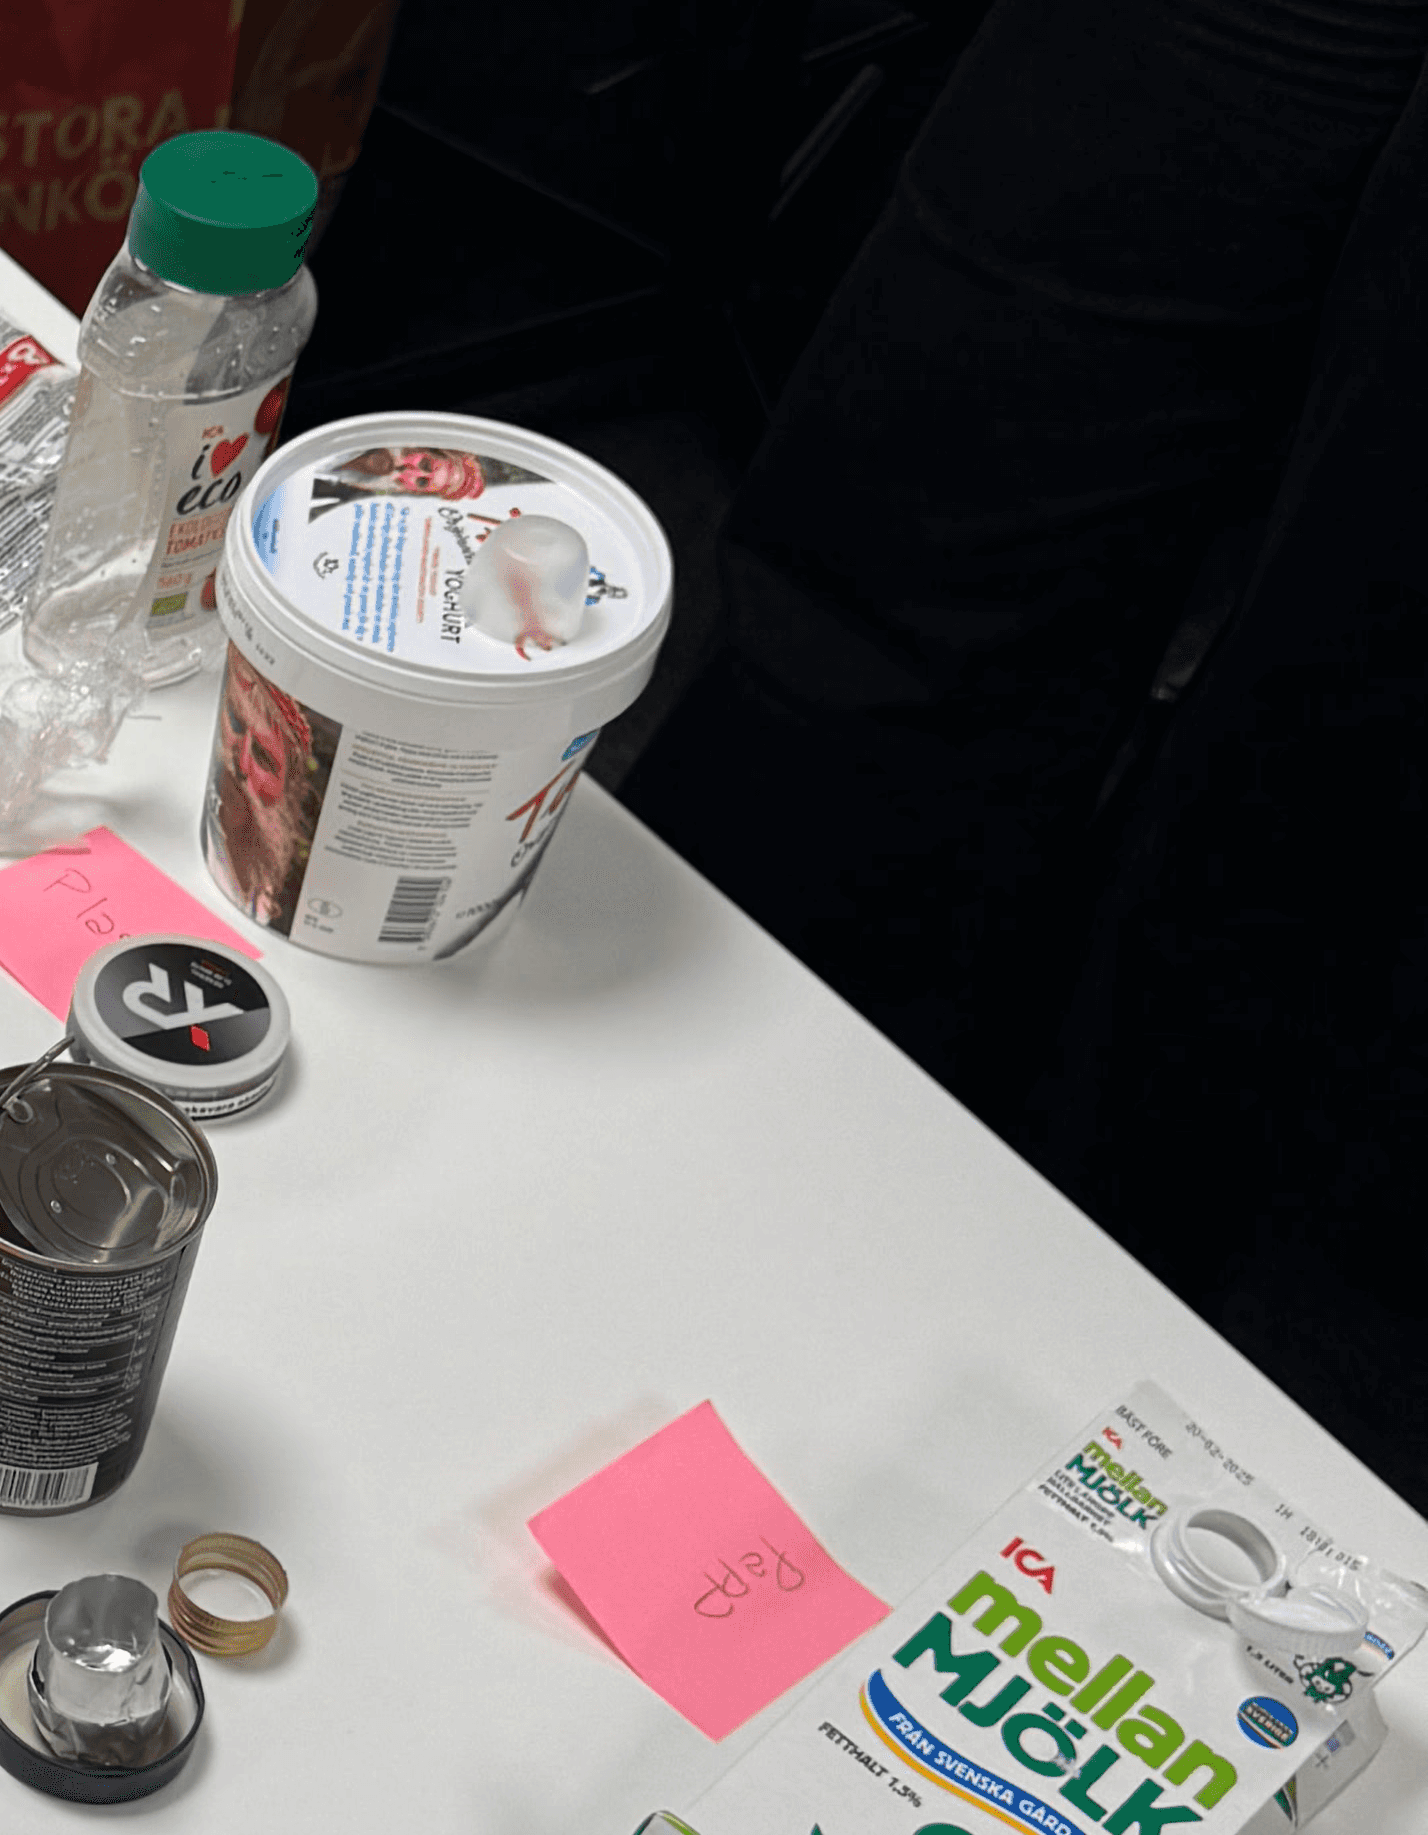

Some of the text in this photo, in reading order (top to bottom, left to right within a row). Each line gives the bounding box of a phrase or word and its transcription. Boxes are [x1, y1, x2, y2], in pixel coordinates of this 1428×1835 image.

[176, 469, 242, 516] eco
[440, 568, 465, 645] YOGHURT
[1064, 1452, 1158, 1530] MJÖLK
[1083, 1440, 1169, 1517] mellan
[999, 1535, 1058, 1596] ICA
[891, 1610, 1205, 1835] MJÖLK
[946, 1568, 1240, 1813] mellan
[817, 1720, 890, 1779] FETTHALT
[887, 1709, 1074, 1835] FRÅN SVENSKA GÅRD
